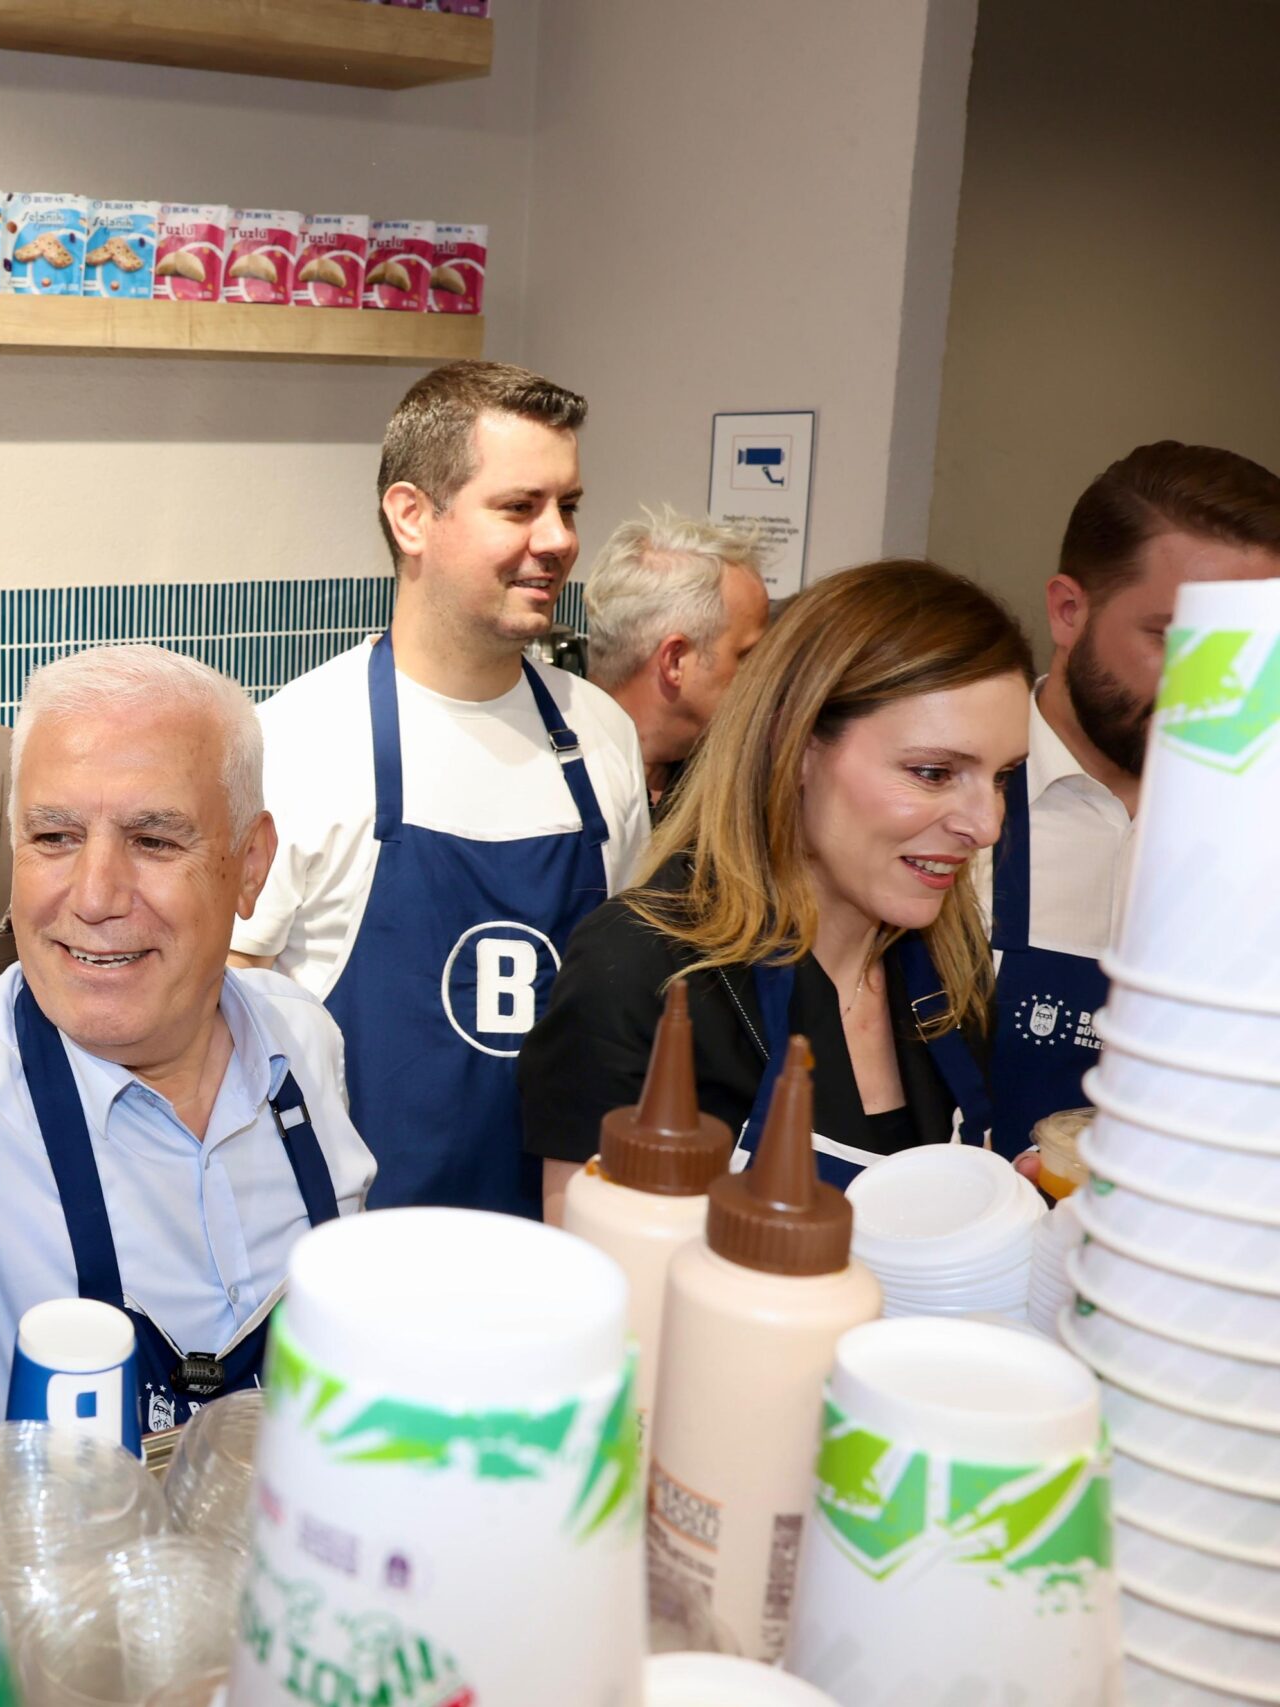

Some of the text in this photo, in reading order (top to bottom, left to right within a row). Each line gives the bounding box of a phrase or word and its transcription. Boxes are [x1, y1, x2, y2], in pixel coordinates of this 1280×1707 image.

[158, 222, 194, 237] Tuzlu
[230, 226, 268, 240] Tuzlu
[300, 231, 337, 245] Tuzlu
[369, 236, 405, 249] Tuzlu
[476, 938, 538, 1034] B
[1079, 1011, 1092, 1025] B
